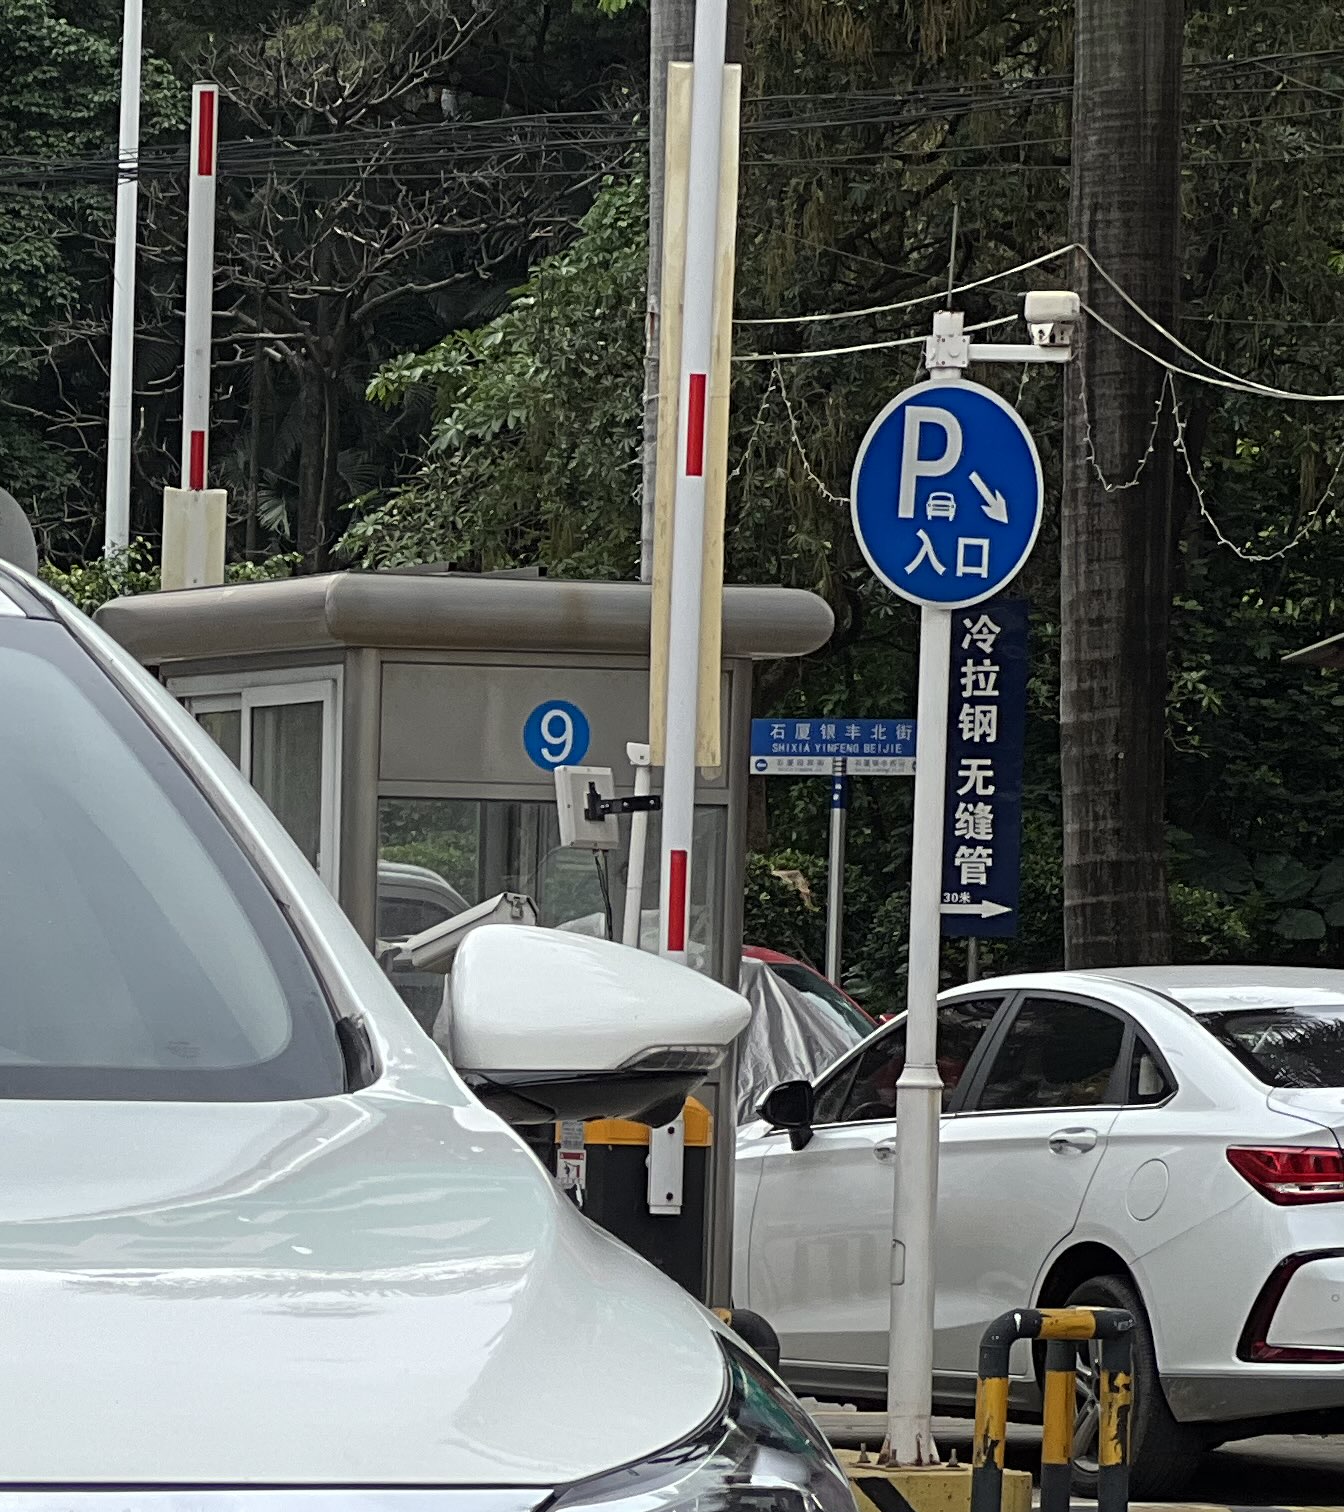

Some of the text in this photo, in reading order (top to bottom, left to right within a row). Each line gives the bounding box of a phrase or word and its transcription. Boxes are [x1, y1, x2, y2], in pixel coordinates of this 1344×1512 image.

[898, 405, 962, 518] P
[904, 528, 990, 578] 入口
[541, 709, 573, 763] 9
[770, 723, 912, 740] 石厦银丰北街
[772, 743, 902, 753] SHIXIA YINFENG BEIJIE
[954, 614, 1001, 885] 冷拉钢 无缝管
[943, 892, 971, 903] 30米
